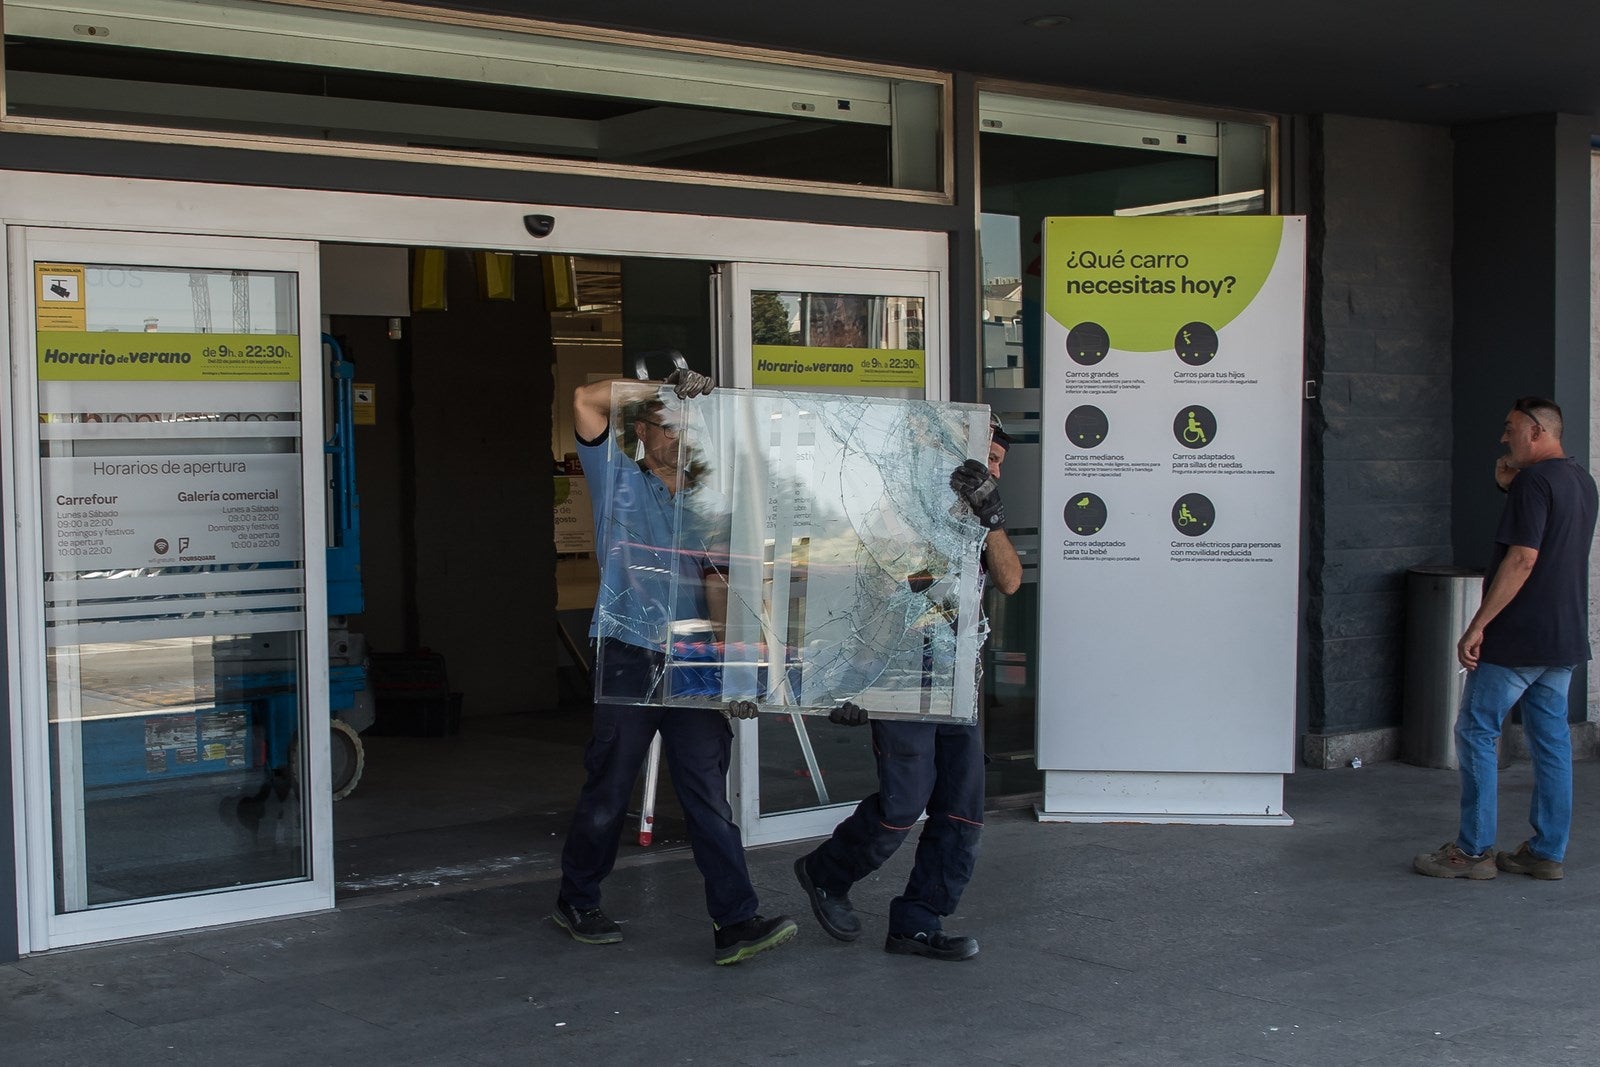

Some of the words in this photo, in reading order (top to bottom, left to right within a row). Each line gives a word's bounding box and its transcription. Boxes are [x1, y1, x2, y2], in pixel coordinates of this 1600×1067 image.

[1066, 249, 1125, 269] ¿Qué
[1130, 254, 1189, 268] carro
[1067, 274, 1176, 294] necesitas
[1181, 274, 1236, 299] hoy?
[202, 346, 217, 357] de
[237, 350, 244, 358] a
[245, 345, 293, 358] 22:30h.
[44, 348, 116, 366] Horario
[116, 354, 129, 364] de
[128, 351, 191, 364] verano
[757, 359, 804, 374] Horario
[804, 364, 813, 372] de
[811, 361, 854, 373] verano
[860, 360, 871, 368] de
[1090, 371, 1119, 380] grandes
[1198, 372, 1215, 380] para
[1228, 371, 1245, 380] hijos
[1197, 453, 1235, 461] adaptados
[93, 461, 158, 475] Horarios
[161, 460, 180, 475] de
[183, 460, 246, 476] apertura
[57, 494, 118, 505] Carrefour
[177, 490, 220, 502] Galería
[222, 489, 279, 501] comercial
[223, 506, 245, 514] Lunes
[251, 505, 279, 513] Sábado
[57, 511, 81, 519] Lunes
[89, 510, 119, 518] Sábado
[228, 514, 251, 522] 09:00
[258, 513, 279, 522] 22:00
[57, 520, 82, 528] 09:00
[90, 519, 113, 528] 22:00
[208, 524, 245, 533] Domingos
[251, 523, 279, 531] festivos
[57, 530, 98, 539] Domingos
[104, 528, 135, 536] festivos
[249, 532, 279, 541] apertura
[70, 538, 105, 548] apertura
[231, 541, 252, 549] 10:00
[258, 540, 280, 548] 22:00
[1088, 540, 1126, 548] adaptados
[58, 548, 82, 556] 10:00
[89, 547, 112, 555] 22:00
